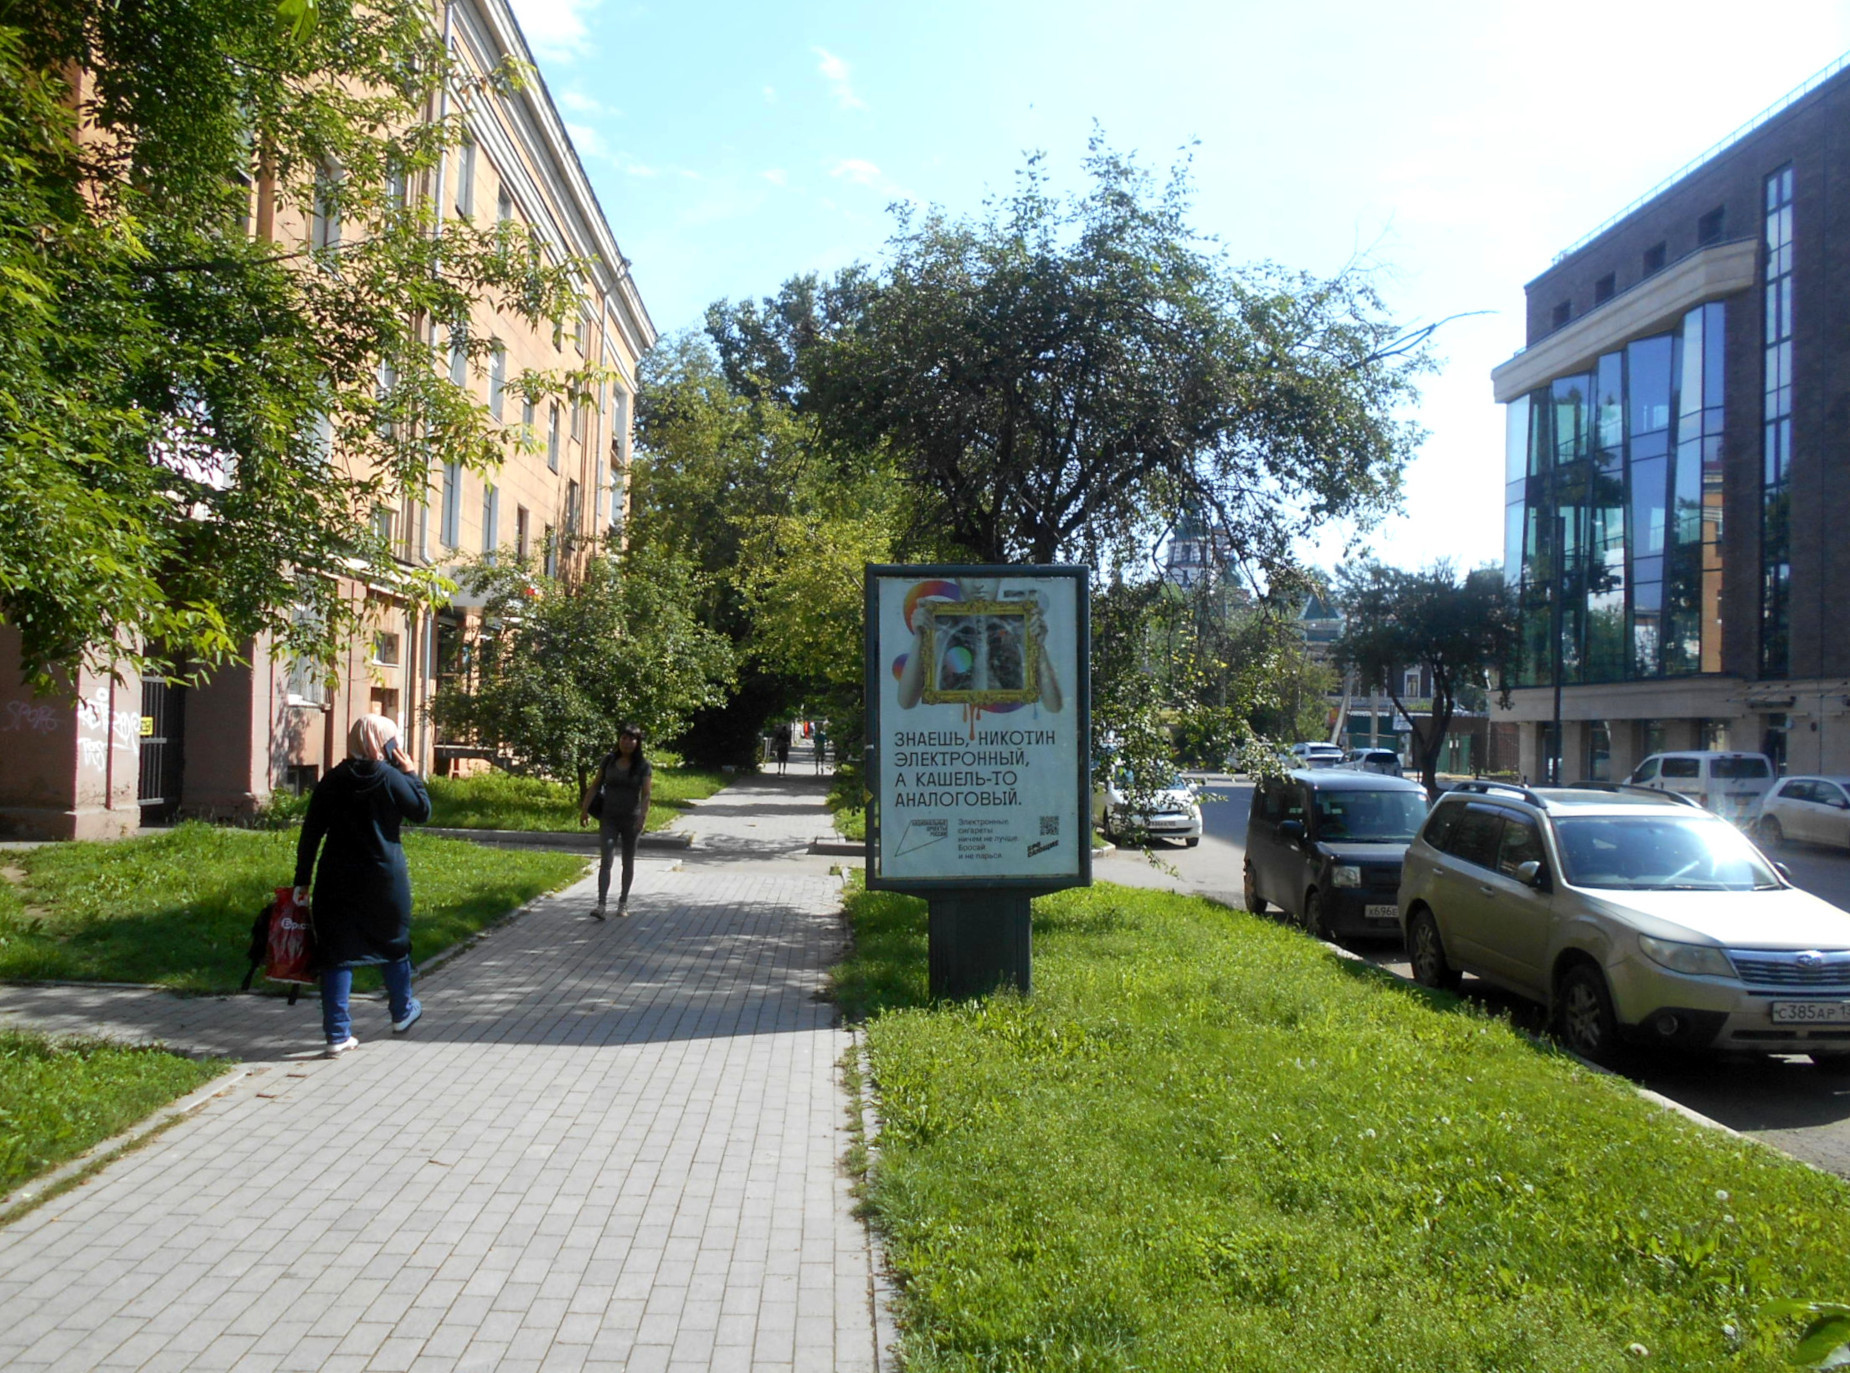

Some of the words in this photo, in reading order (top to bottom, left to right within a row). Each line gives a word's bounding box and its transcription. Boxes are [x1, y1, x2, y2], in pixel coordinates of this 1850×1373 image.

[894, 731, 970, 747] ЗНАЕШЬ,
[978, 730, 1056, 746] НИКОТИН
[894, 748, 1030, 767] ЭЛЕКТРОННЫЙ,
[894, 772, 907, 787] А
[915, 770, 1018, 787] КАШЕЛЬ-ТО
[894, 788, 1022, 807] АНАЛОГОВЫЙ.
[957, 827, 993, 835] сигареты
[958, 844, 986, 852] Бросай
[1778, 1004, 1836, 1019] С385АР
